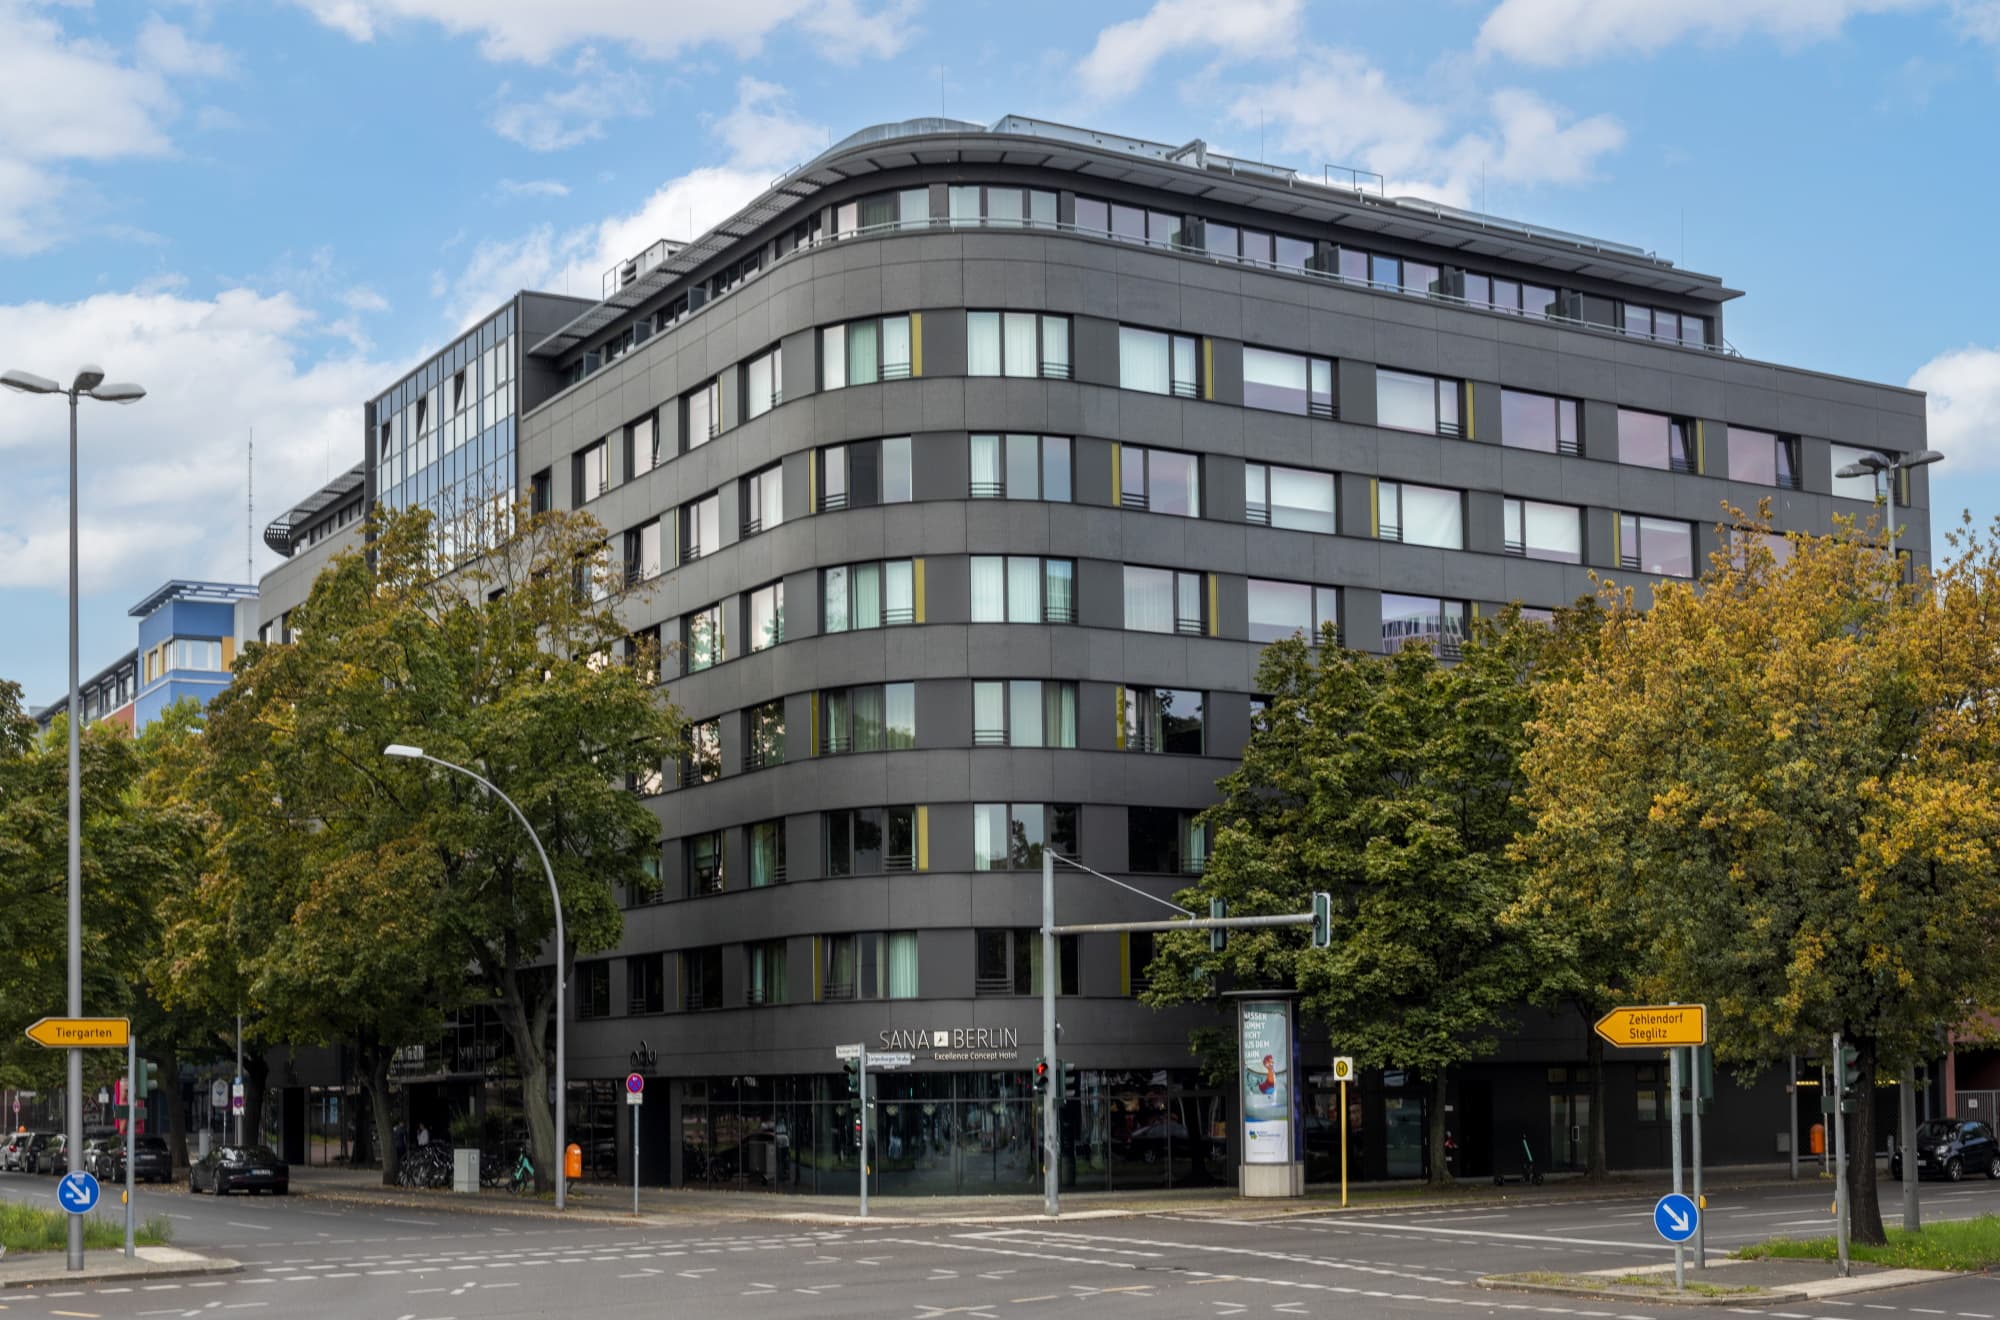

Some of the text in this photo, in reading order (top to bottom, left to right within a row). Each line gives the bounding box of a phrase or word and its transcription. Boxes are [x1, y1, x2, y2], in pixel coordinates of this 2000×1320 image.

[1629, 1012, 1683, 1024] Zehlendorf
[56, 1027, 112, 1040] Tiergarten
[879, 1027, 1017, 1050] SANA BERLIN
[1629, 1027, 1668, 1041] Steglitz
[934, 1050, 1018, 1061] Excellence Concept Hotel
